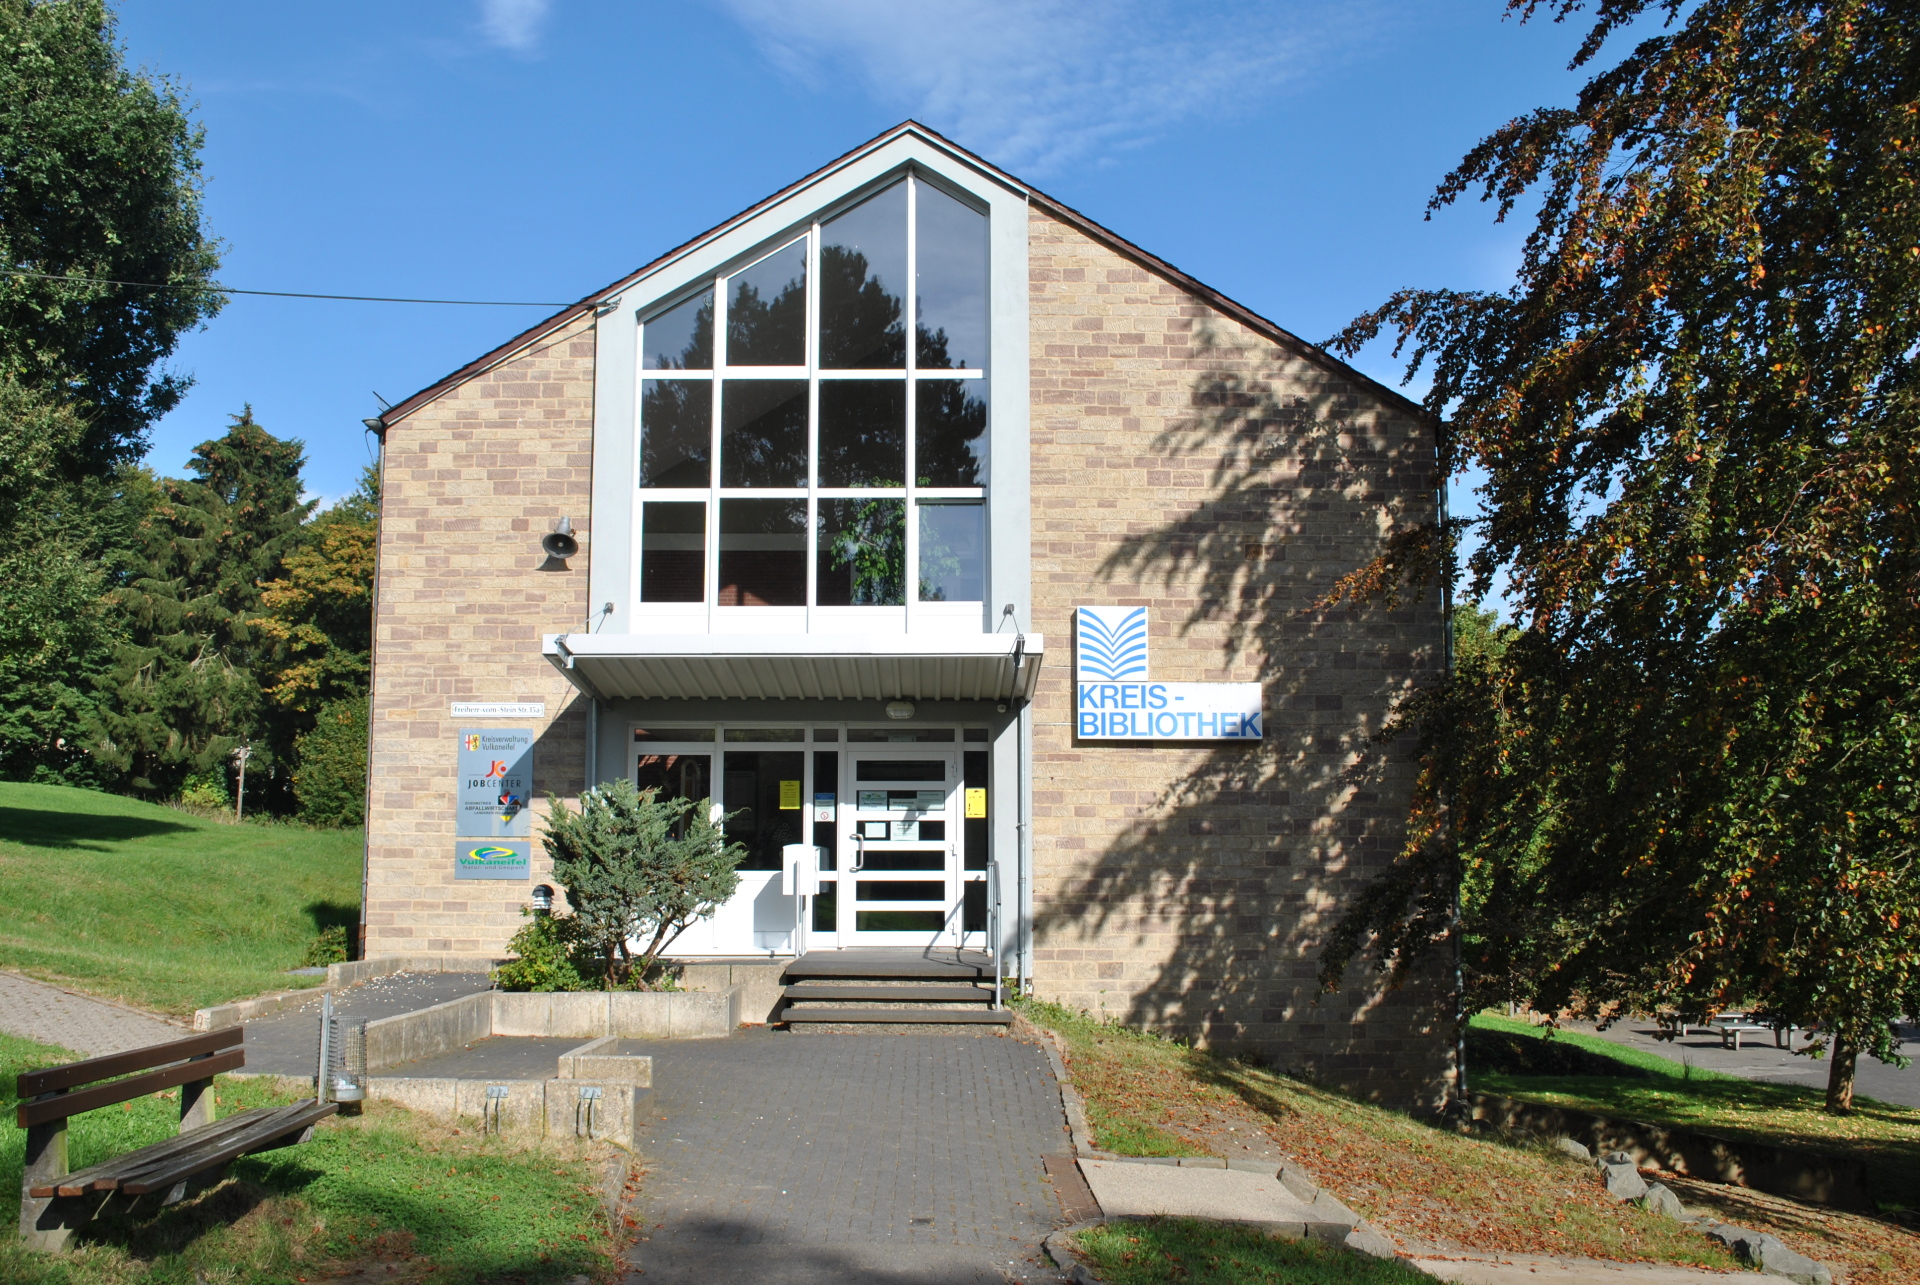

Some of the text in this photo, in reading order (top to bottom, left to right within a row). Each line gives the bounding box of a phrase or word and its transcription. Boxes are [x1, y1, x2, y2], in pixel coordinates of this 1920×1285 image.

[1079, 711, 1262, 737] BIBLIOTHEK
[482, 735, 528, 744] Kreisverwaltung
[482, 743, 516, 751] Vulkaneifel
[467, 779, 522, 789] JOBCENTER
[459, 858, 527, 866] Vulkaneifel
